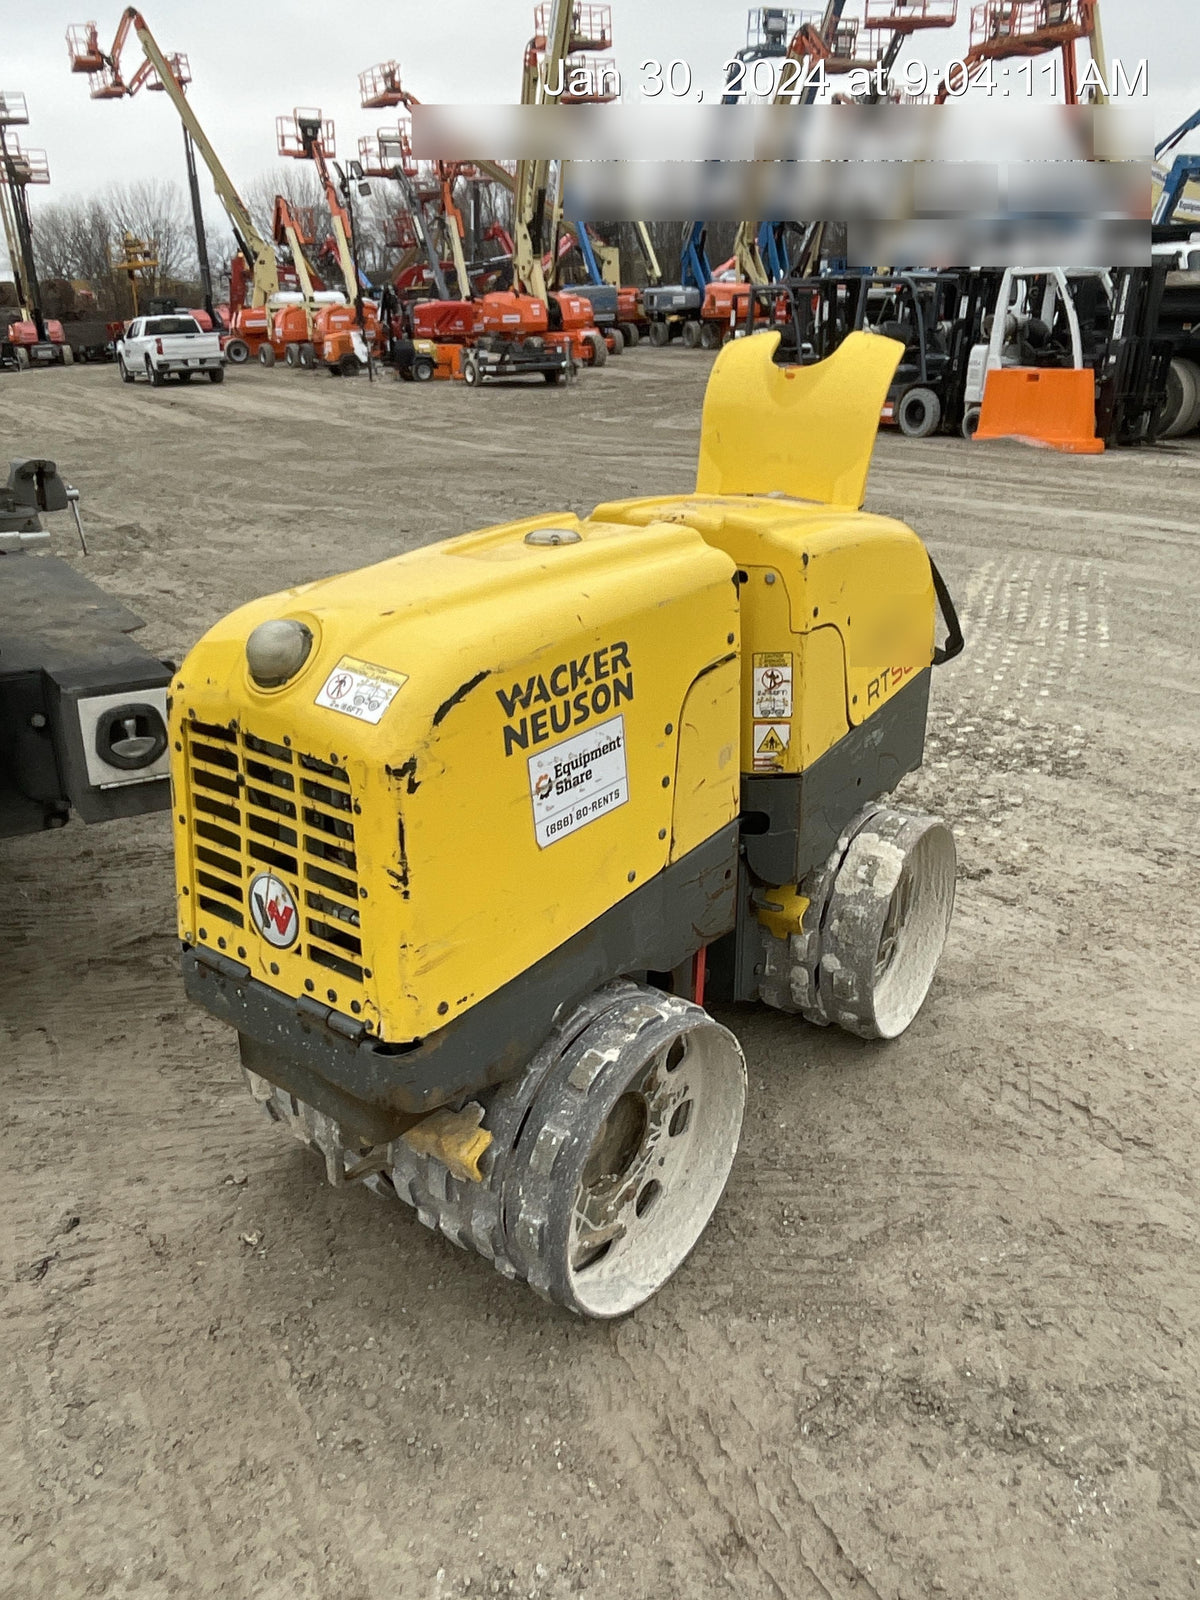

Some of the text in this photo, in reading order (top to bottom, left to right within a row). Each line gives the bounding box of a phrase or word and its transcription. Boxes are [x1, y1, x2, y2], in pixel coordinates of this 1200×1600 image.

[495, 641, 632, 719] WACKER
[502, 672, 634, 757] NEUSON
[553, 735, 622, 779] Equipment
[555, 769, 593, 796] Share
[545, 788, 620, 837] (888) 80-RENTS
